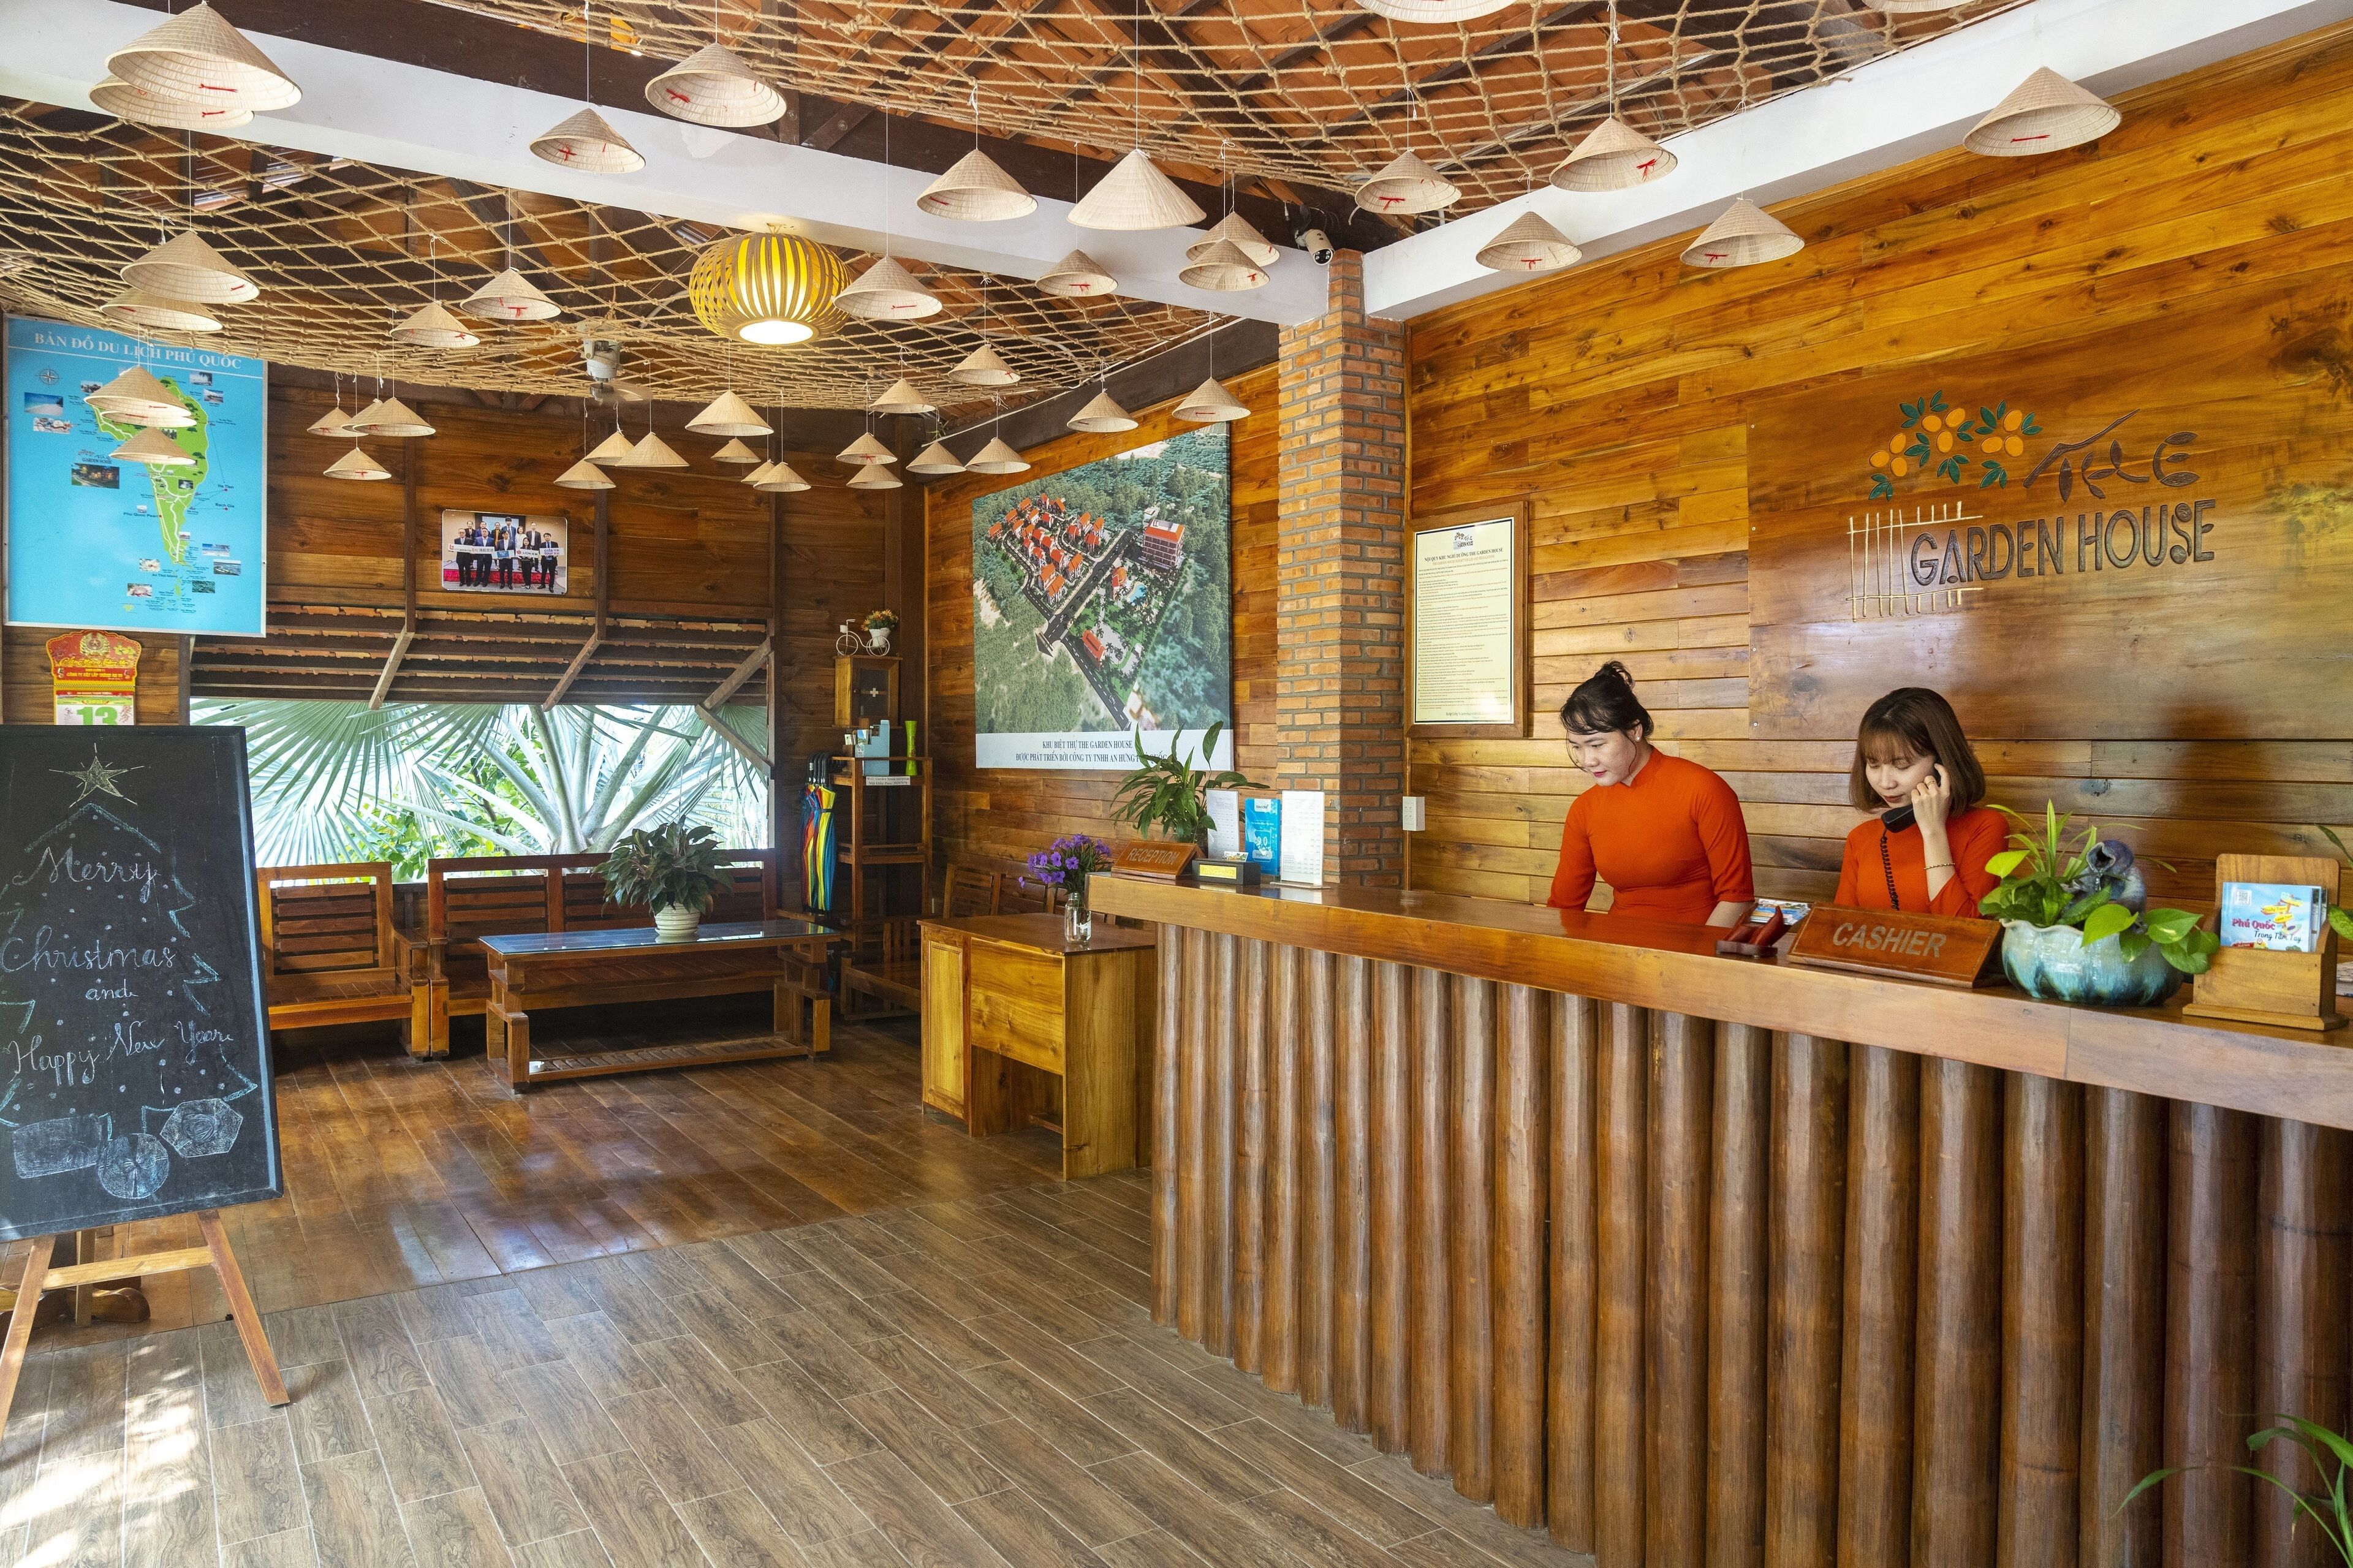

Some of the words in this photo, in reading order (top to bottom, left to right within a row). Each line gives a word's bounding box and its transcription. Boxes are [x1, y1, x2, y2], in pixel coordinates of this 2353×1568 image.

[34, 331, 67, 347] BẢN
[71, 335, 94, 350] ĐỒ
[98, 341, 119, 354] DU
[124, 344, 161, 359] LỊCH
[165, 350, 195, 363] PHÚ
[1911, 516, 2064, 586] GARDEN
[2078, 498, 2216, 574] HOUSE
[77, 706, 118, 725] 13
[1054, 739, 1066, 751] BIỆT
[1066, 740, 1077, 751] THỰ
[1089, 740, 1113, 749] GARDEN
[1113, 740, 1133, 749] HOUSE
[1016, 752, 1029, 763] ĐƯỢC
[1029, 751, 1042, 761] PHÁT
[1043, 750, 1058, 762] TRIỂN
[1059, 751, 1068, 762] BỞI
[1069, 752, 1084, 762] CÔNG
[1093, 754, 1108, 762] TNHH
[1110, 754, 1118, 762] AN
[1119, 753, 1135, 762] HƯNG
[1126, 848, 1180, 865] RECEPTION
[12, 844, 161, 904] Merry
[2232, 918, 2250, 928] Phú
[2251, 919, 2275, 930] Quốc
[1832, 922, 1947, 958] CASHIER
[2254, 930, 2273, 941] Trong
[2289, 933, 2302, 944] Tay
[1, 925, 177, 972] Christmas
[85, 979, 138, 1001] and
[1, 1034, 100, 1087] Happy
[106, 1020, 165, 1061] New
[173, 1020, 233, 1066] Year
